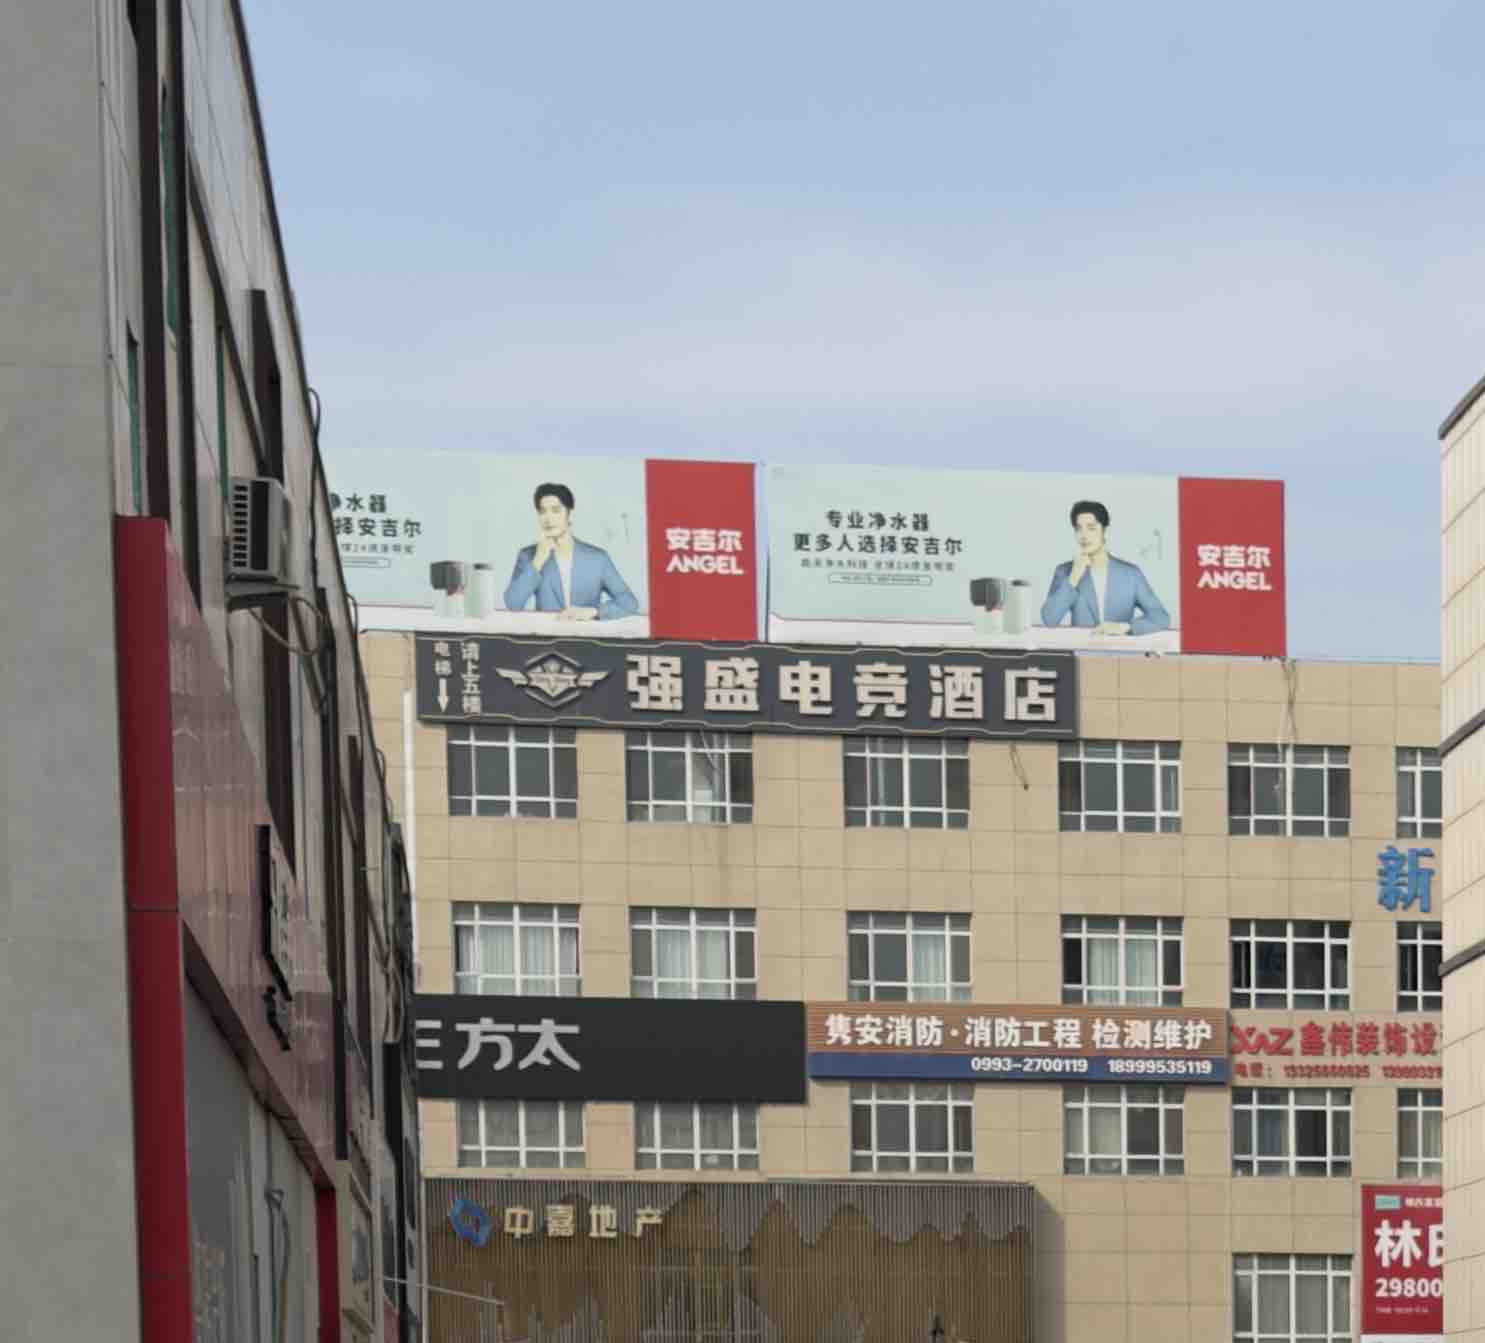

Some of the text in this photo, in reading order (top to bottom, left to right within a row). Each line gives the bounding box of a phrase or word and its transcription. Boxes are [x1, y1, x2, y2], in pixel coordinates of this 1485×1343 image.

[827, 510, 928, 531] 专业净水器
[666, 527, 743, 552] 安吉尔
[793, 532, 963, 556] 更多人选择安吉尔
[666, 558, 745, 577] ANGEL
[1197, 545, 1271, 568] 安吉尔
[1197, 571, 1272, 591] ANGEL
[625, 655, 1058, 722] 强盛电竞酒店
[1377, 845, 1435, 913] 新
[1092, 1018, 1213, 1051] 检测维护
[970, 1057, 1213, 1076] 0993-2700119 18999535119
